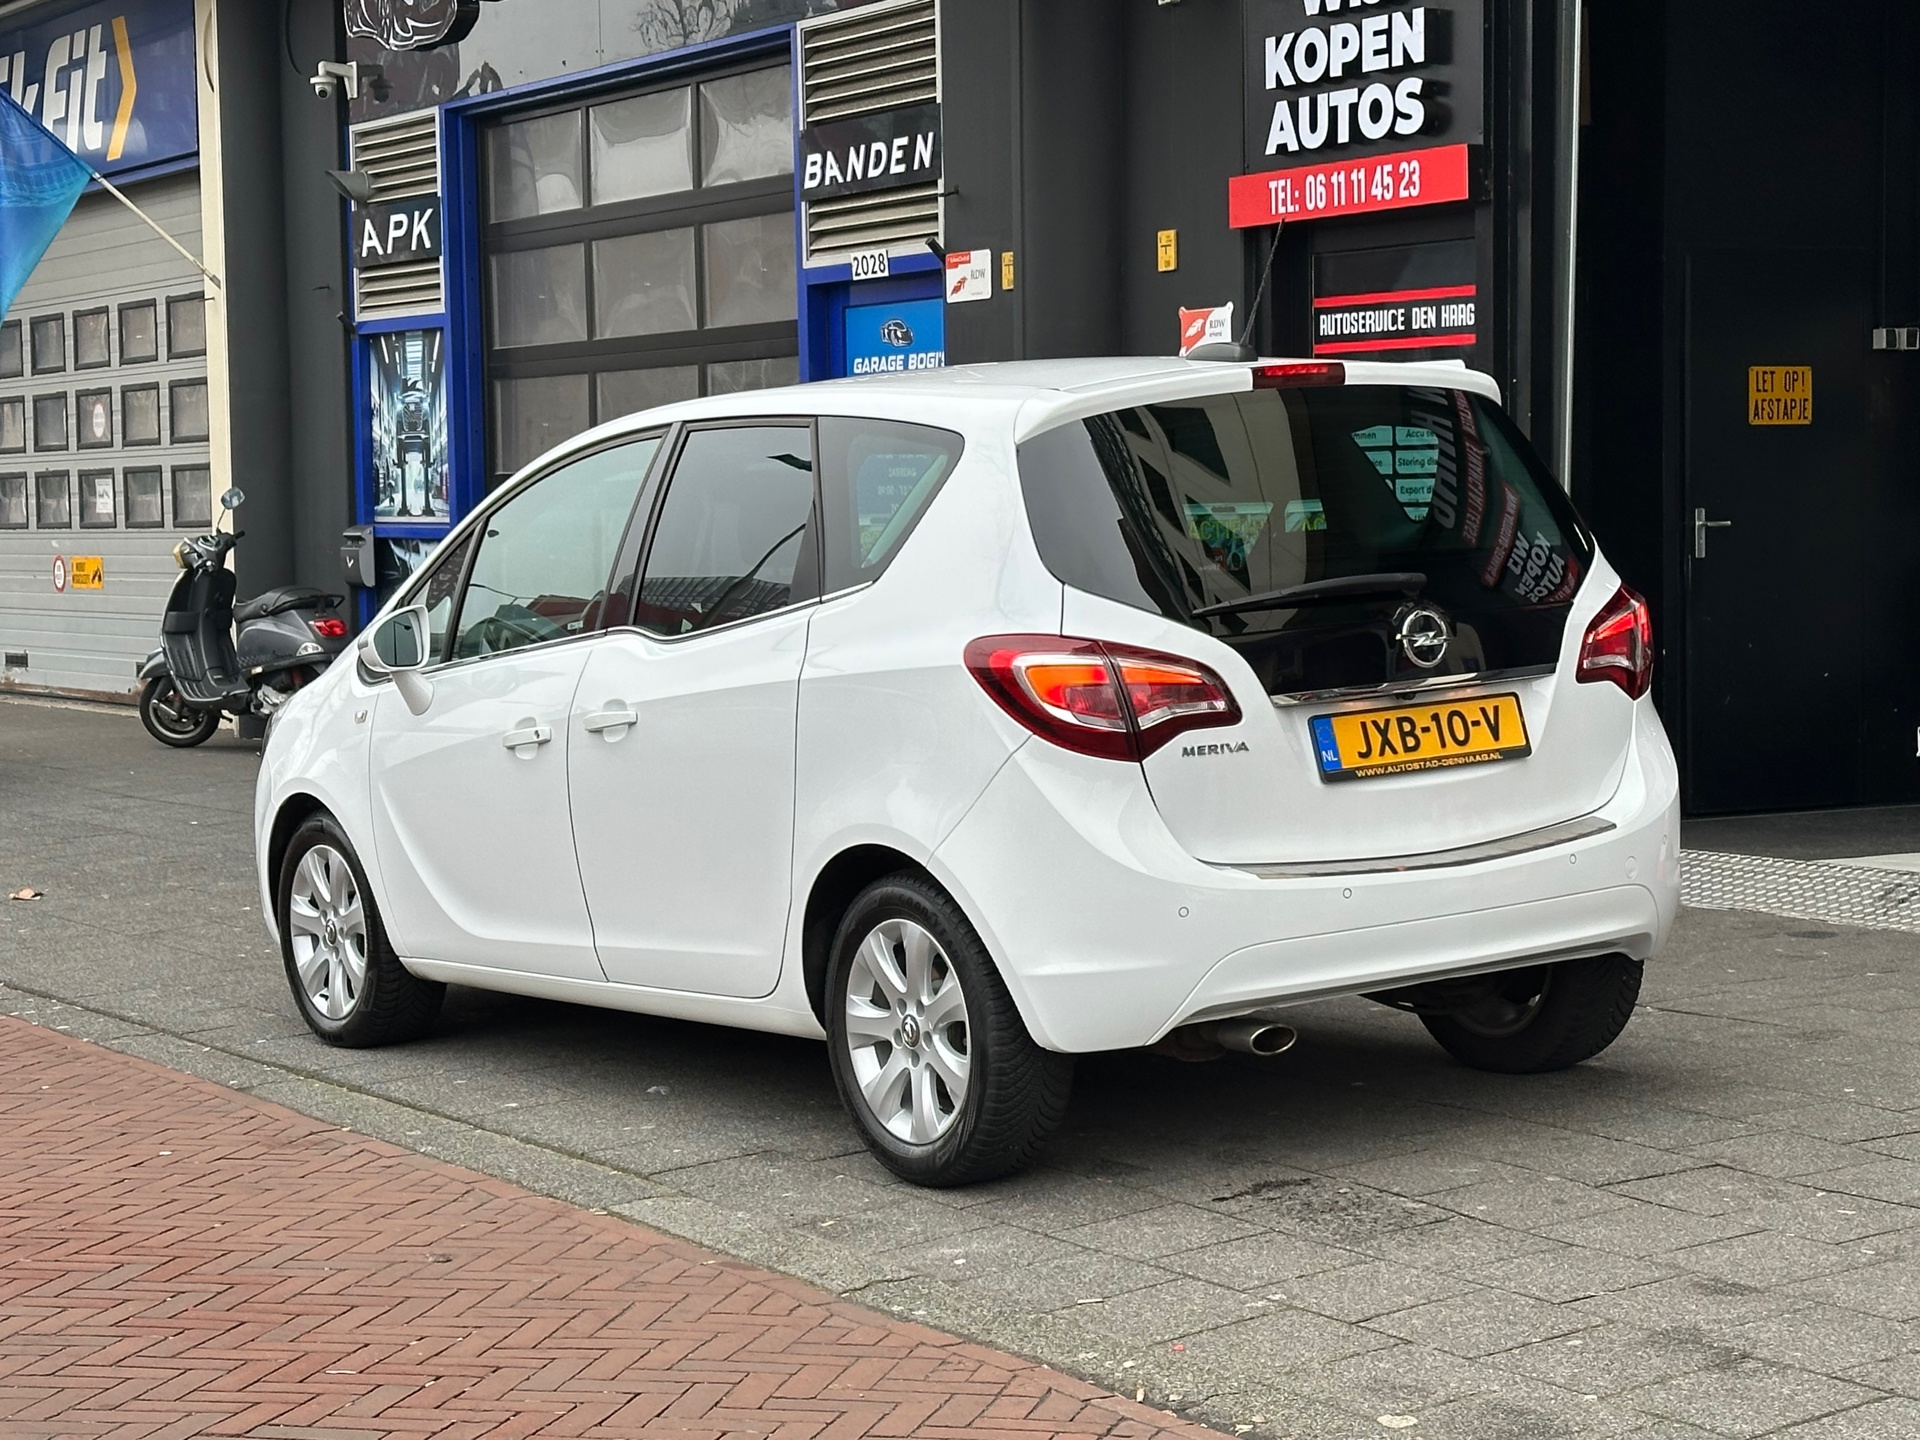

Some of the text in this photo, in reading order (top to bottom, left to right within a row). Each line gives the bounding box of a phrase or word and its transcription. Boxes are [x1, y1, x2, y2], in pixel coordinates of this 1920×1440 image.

[1265, 7, 1425, 90] KOPEN
[42, 24, 106, 154] Fit
[1265, 77, 1424, 155] AUTOS
[803, 131, 935, 190] BANDEN
[1268, 159, 1421, 215] TEL: 06 11 11 45 23
[361, 208, 433, 257] APK
[853, 252, 886, 277] 2028
[970, 268, 986, 280] RDW
[1209, 318, 1226, 329] RDW
[1319, 303, 1475, 336] AUTOSERVICE DEN HAAG
[853, 354, 905, 374] GARAGE
[1755, 371, 1806, 393] LET OP!
[1753, 398, 1809, 421] AFSTAPJE
[1406, 429, 1424, 438] Accu
[1398, 457, 1425, 470] Storing
[1400, 486, 1425, 497] Export
[1357, 705, 1500, 759] JXB-10-V
[1181, 741, 1250, 758] MERIVA
[1322, 750, 1338, 762] NL
[1355, 751, 1503, 778] WWW.AUTOSTAD-DENHAAG.NL
